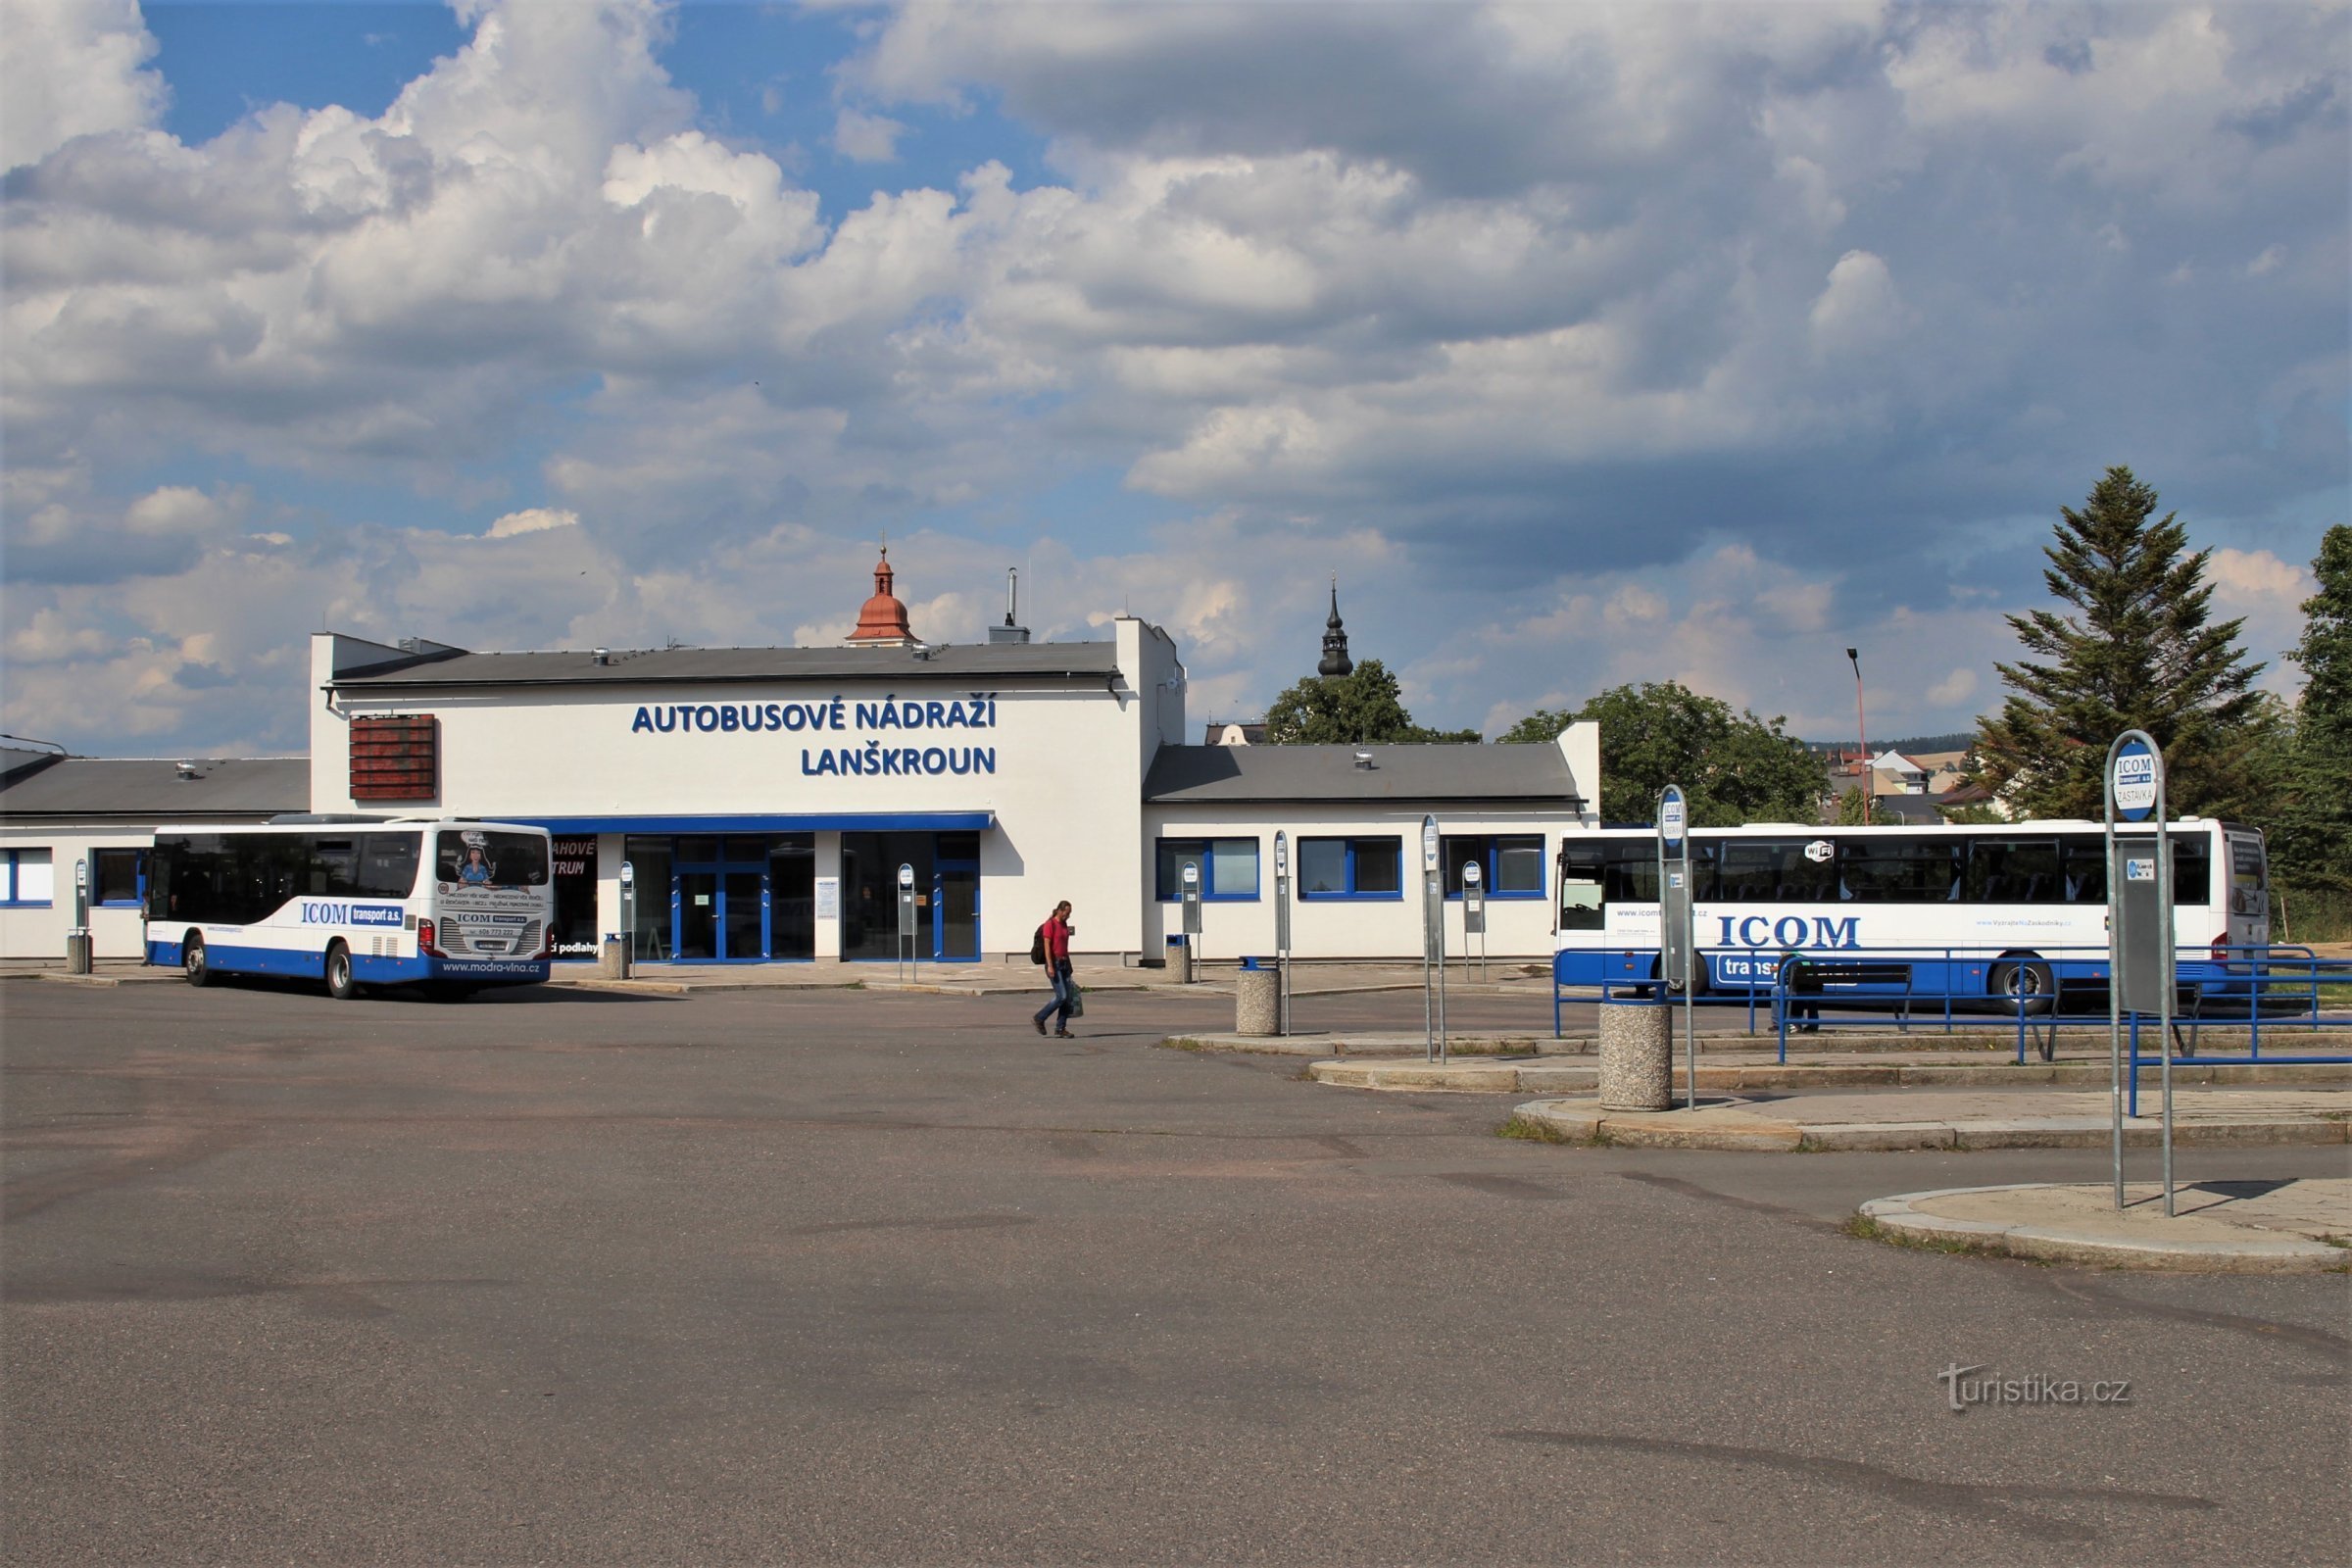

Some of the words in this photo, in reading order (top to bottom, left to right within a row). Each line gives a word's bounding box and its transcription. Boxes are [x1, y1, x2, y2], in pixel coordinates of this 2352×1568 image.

[631, 695, 846, 733] AUTOBUSOVÉ
[856, 692, 997, 730] NÁDRAŽÍ
[802, 740, 996, 776] LANŠKROUN
[2118, 759, 2152, 773] ICOM
[2118, 788, 2153, 803] ZASTÁVKA
[552, 839, 596, 856] AHOVÉ
[552, 860, 585, 875] TRUM
[301, 903, 348, 925] ICOM
[353, 907, 386, 923] transport
[387, 909, 401, 921] a.s.
[458, 913, 490, 923] ICOM
[1717, 916, 1861, 948] ICOM
[559, 942, 599, 956] podlahy
[443, 962, 540, 973] www.modra-vlna.cz
